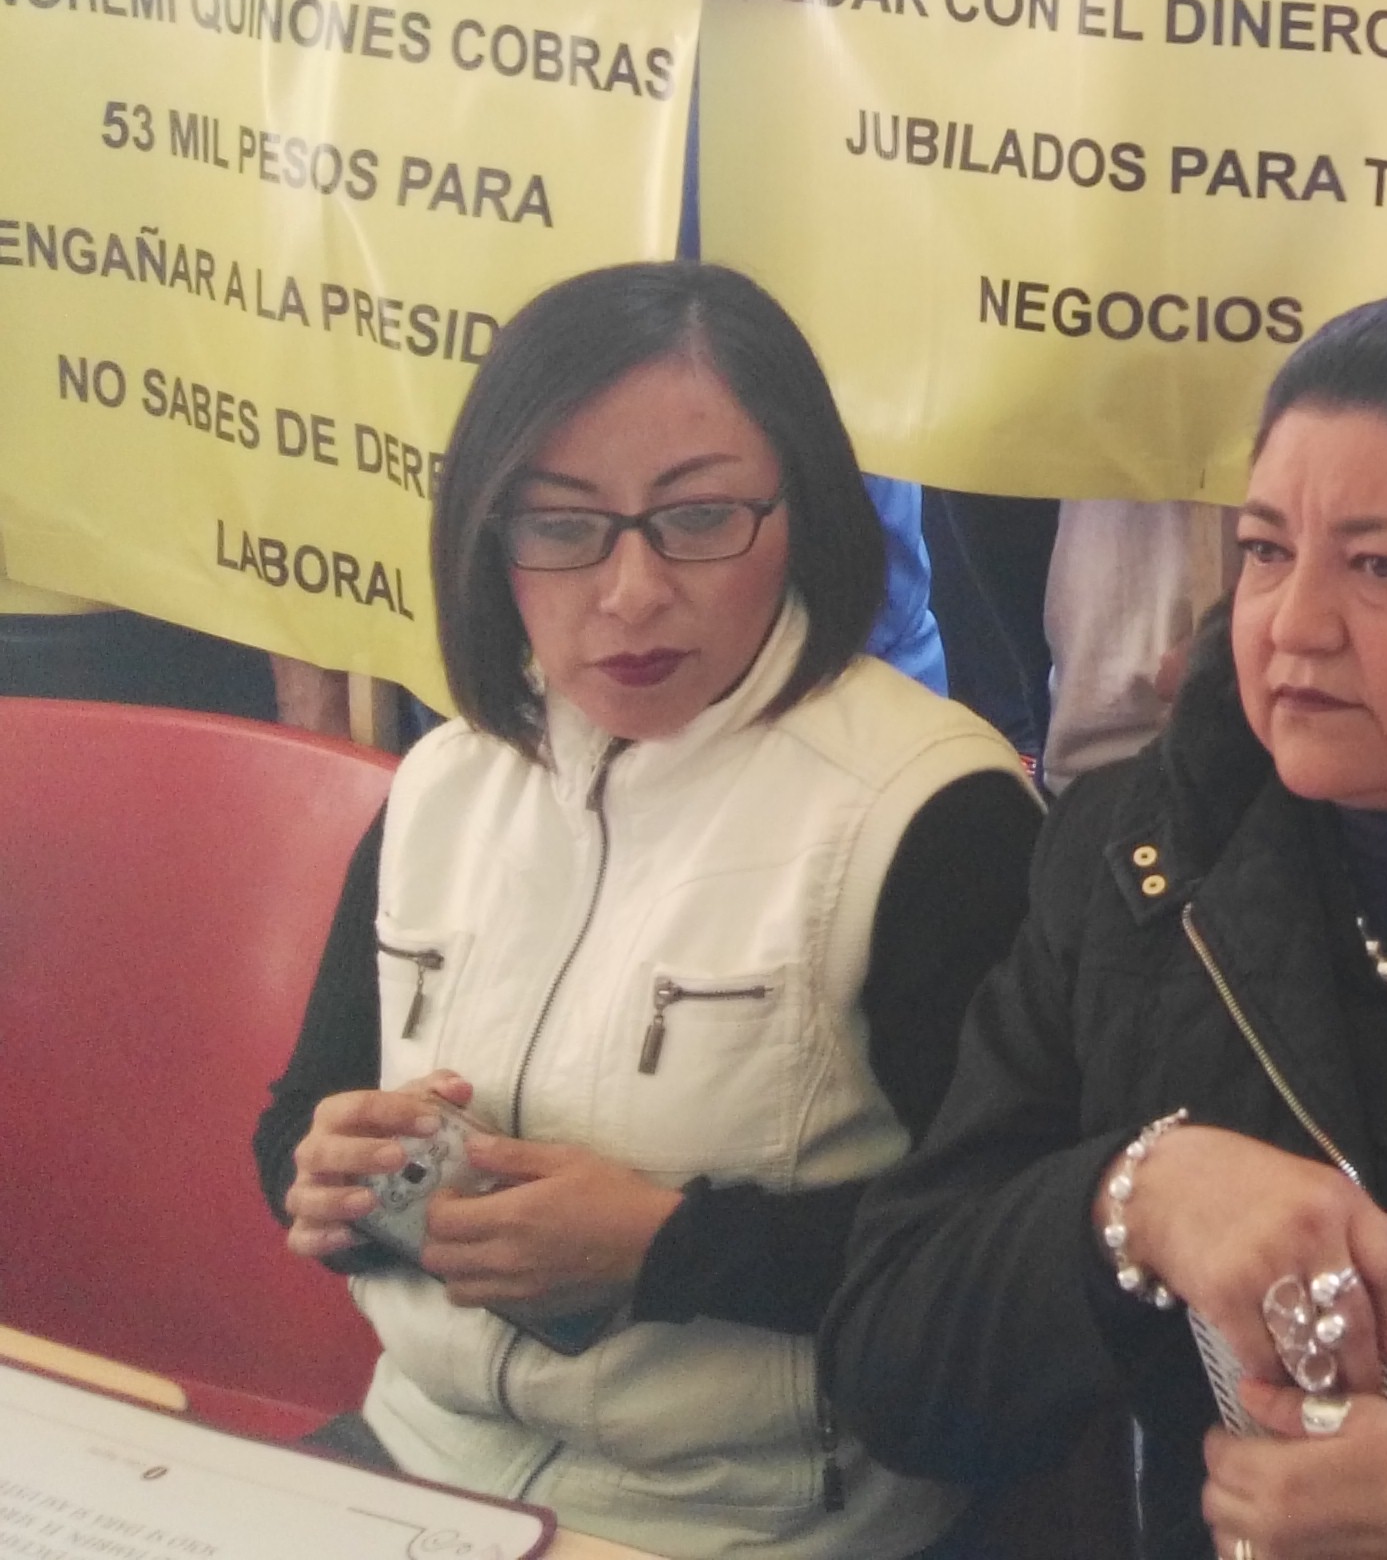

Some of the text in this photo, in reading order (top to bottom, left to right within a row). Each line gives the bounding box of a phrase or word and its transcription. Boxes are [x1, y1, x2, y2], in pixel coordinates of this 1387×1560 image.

[450, 18, 675, 103] COBRAS
[101, 101, 554, 228] 53 MIL PESOS PARA
[846, 109, 1147, 193] JUBILADOS
[1170, 146, 1346, 203] PARA
[0, 220, 216, 301] ENGAÑAR
[224, 269, 249, 309] A
[255, 268, 309, 326] LA
[979, 275, 1303, 345] NEGOCIOS
[57, 354, 126, 408] NO
[142, 368, 260, 450] SABES
[276, 407, 339, 467] DE
[216, 519, 415, 621] LABORAL
